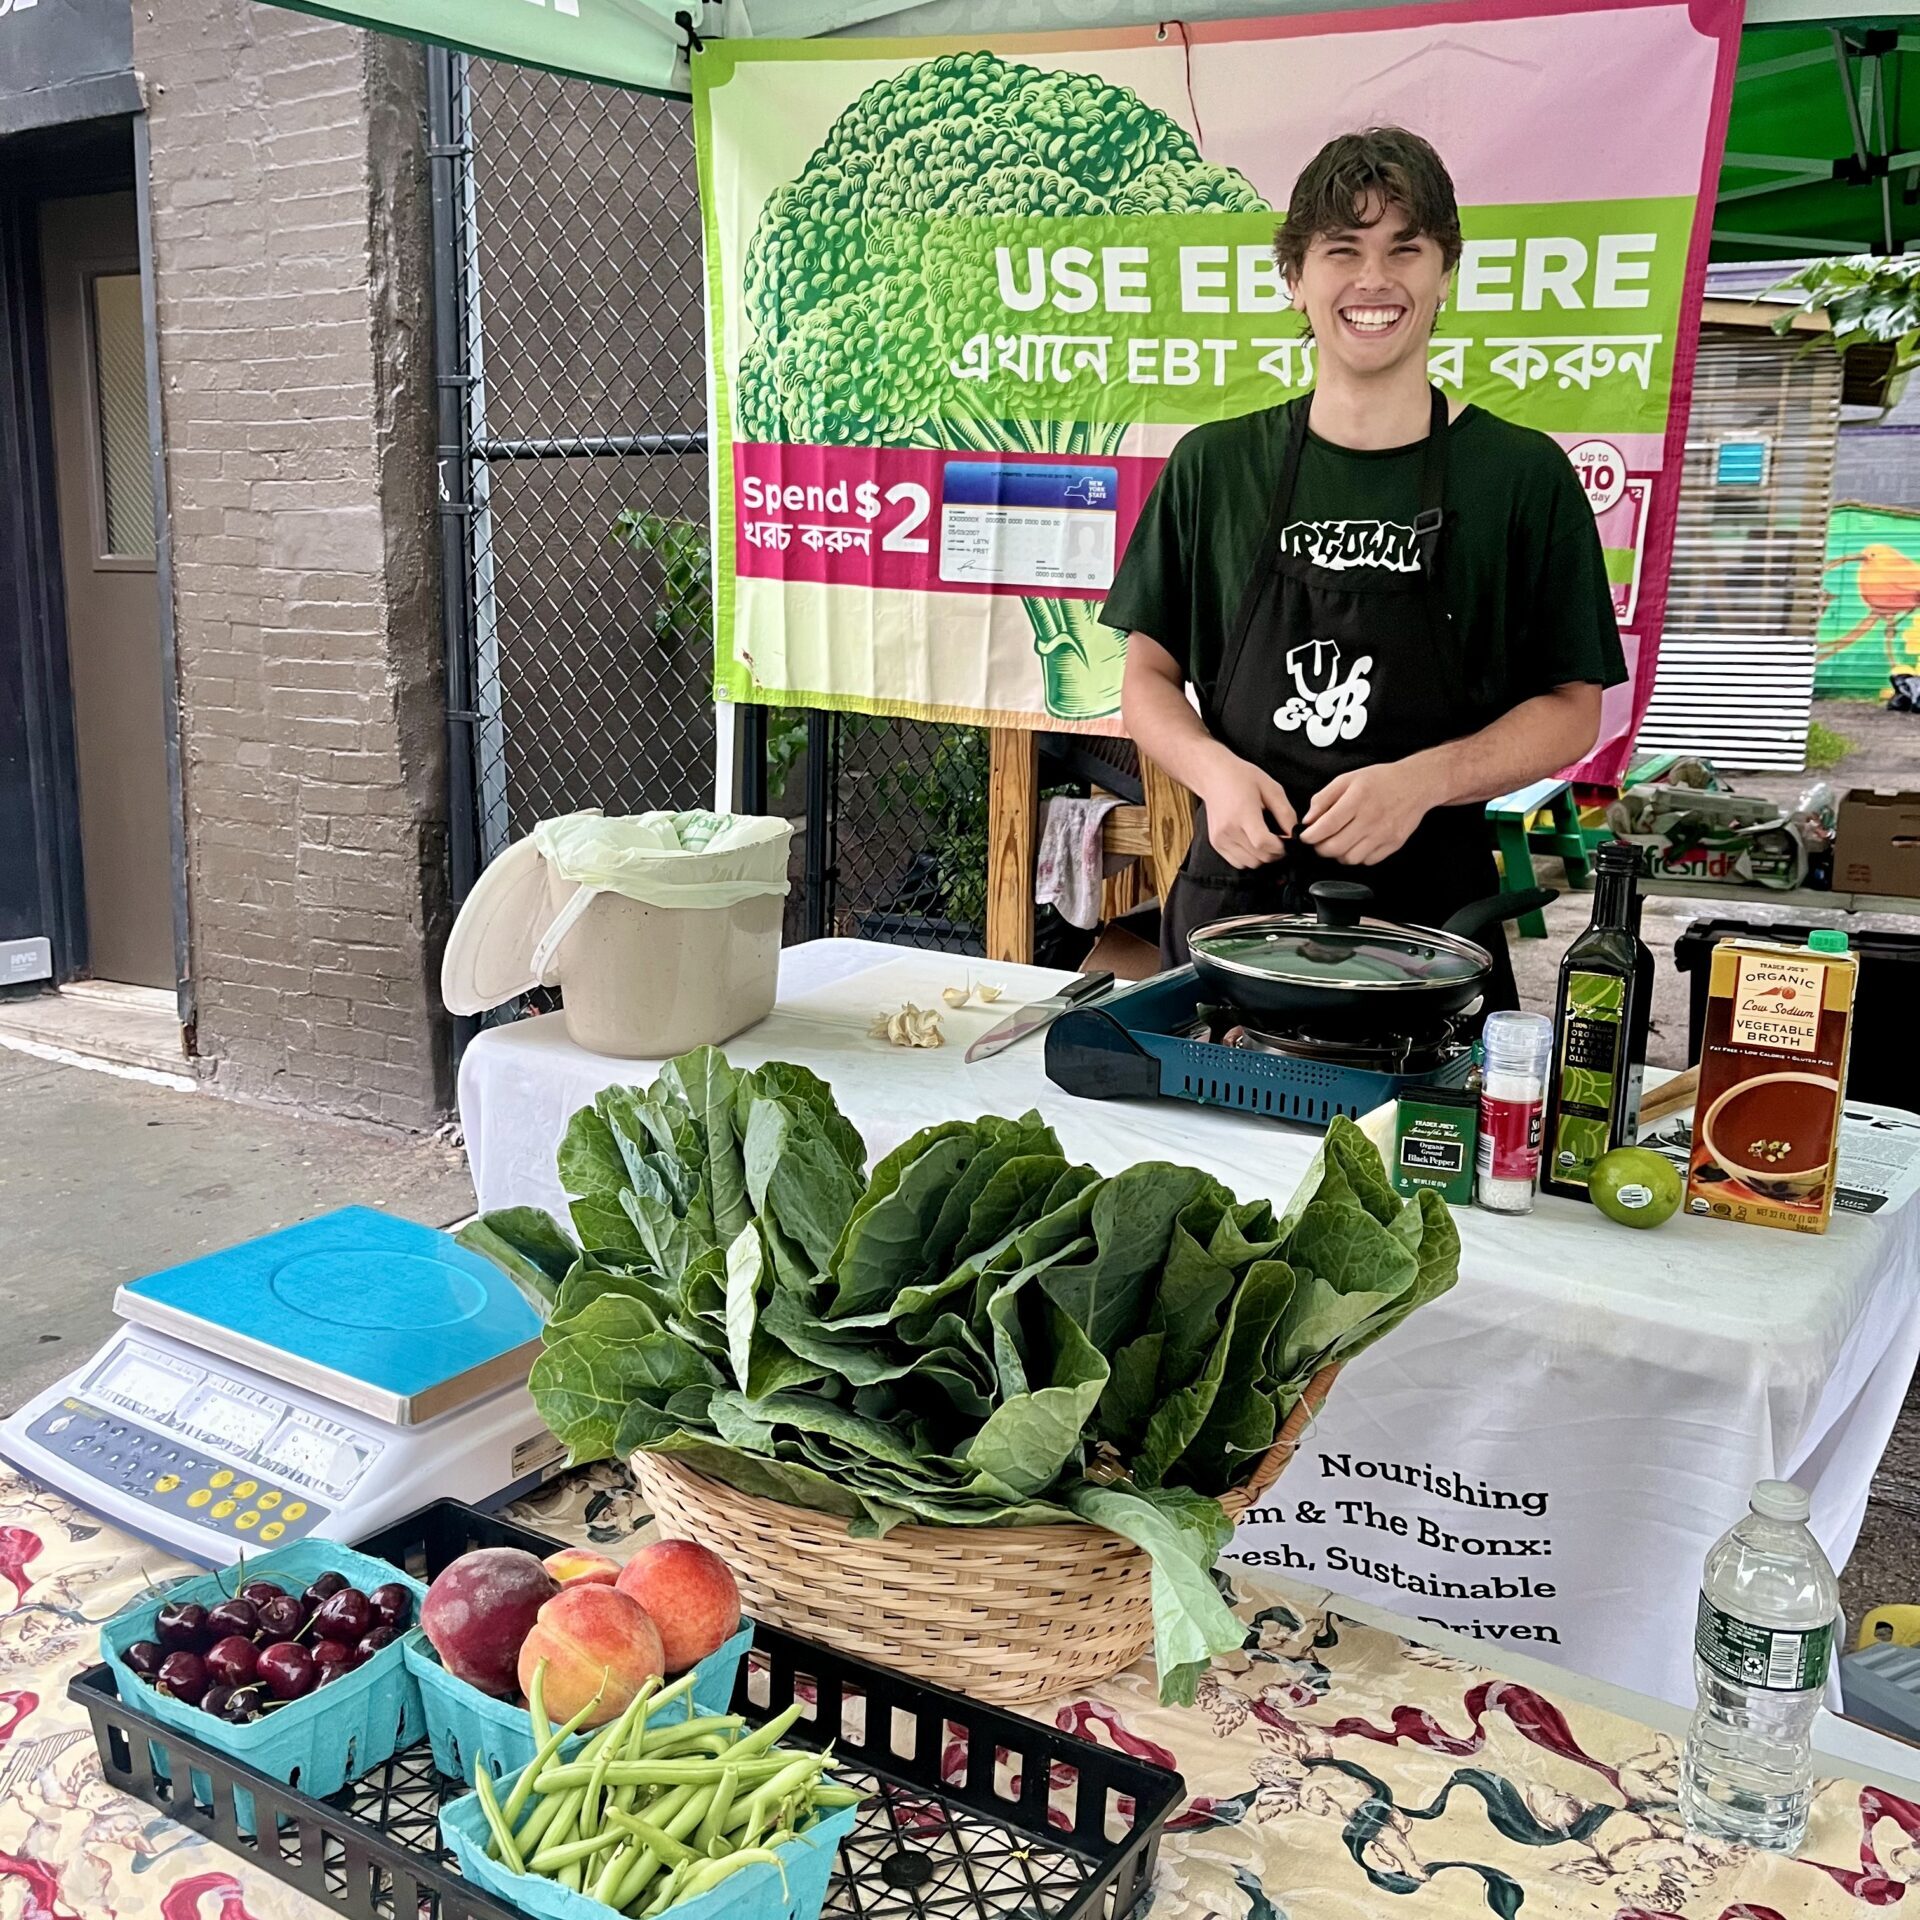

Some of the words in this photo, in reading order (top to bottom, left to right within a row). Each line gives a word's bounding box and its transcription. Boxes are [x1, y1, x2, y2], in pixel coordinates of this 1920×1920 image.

[994, 246, 1152, 314] USE
[1179, 245, 1293, 314] EB
[1441, 233, 1657, 312] ERE
[950, 333, 1112, 383] এখানে
[1128, 338, 1237, 386] EBT
[1484, 333, 1663, 391] করুন
[1580, 452, 1595, 462] Up
[1598, 452, 1609, 463] to
[742, 476, 849, 516] Spend
[1591, 493, 1611, 504] day
[743, 521, 794, 551] খরচ
[798, 524, 872, 556] করুন
[1746, 973, 1815, 989] ORGANIC
[1742, 1000, 1767, 1012] Low
[1770, 1003, 1815, 1018] Sodium
[1737, 1019, 1815, 1037] VEGETABLE
[1747, 1032, 1800, 1047] BROTH
[1407, 1154, 1429, 1163] Black
[1429, 1156, 1456, 1167] Pepper
[1419, 1142, 1446, 1151] Organic
[1420, 1149, 1443, 1157] Ground
[1318, 1453, 1549, 1518] Nourishing
[1295, 1501, 1326, 1524] &
[1335, 1501, 1408, 1537] The
[1417, 1516, 1552, 1557] Bronx:
[1222, 1543, 1316, 1571] esh,
[1326, 1547, 1557, 1601] Sustainable
